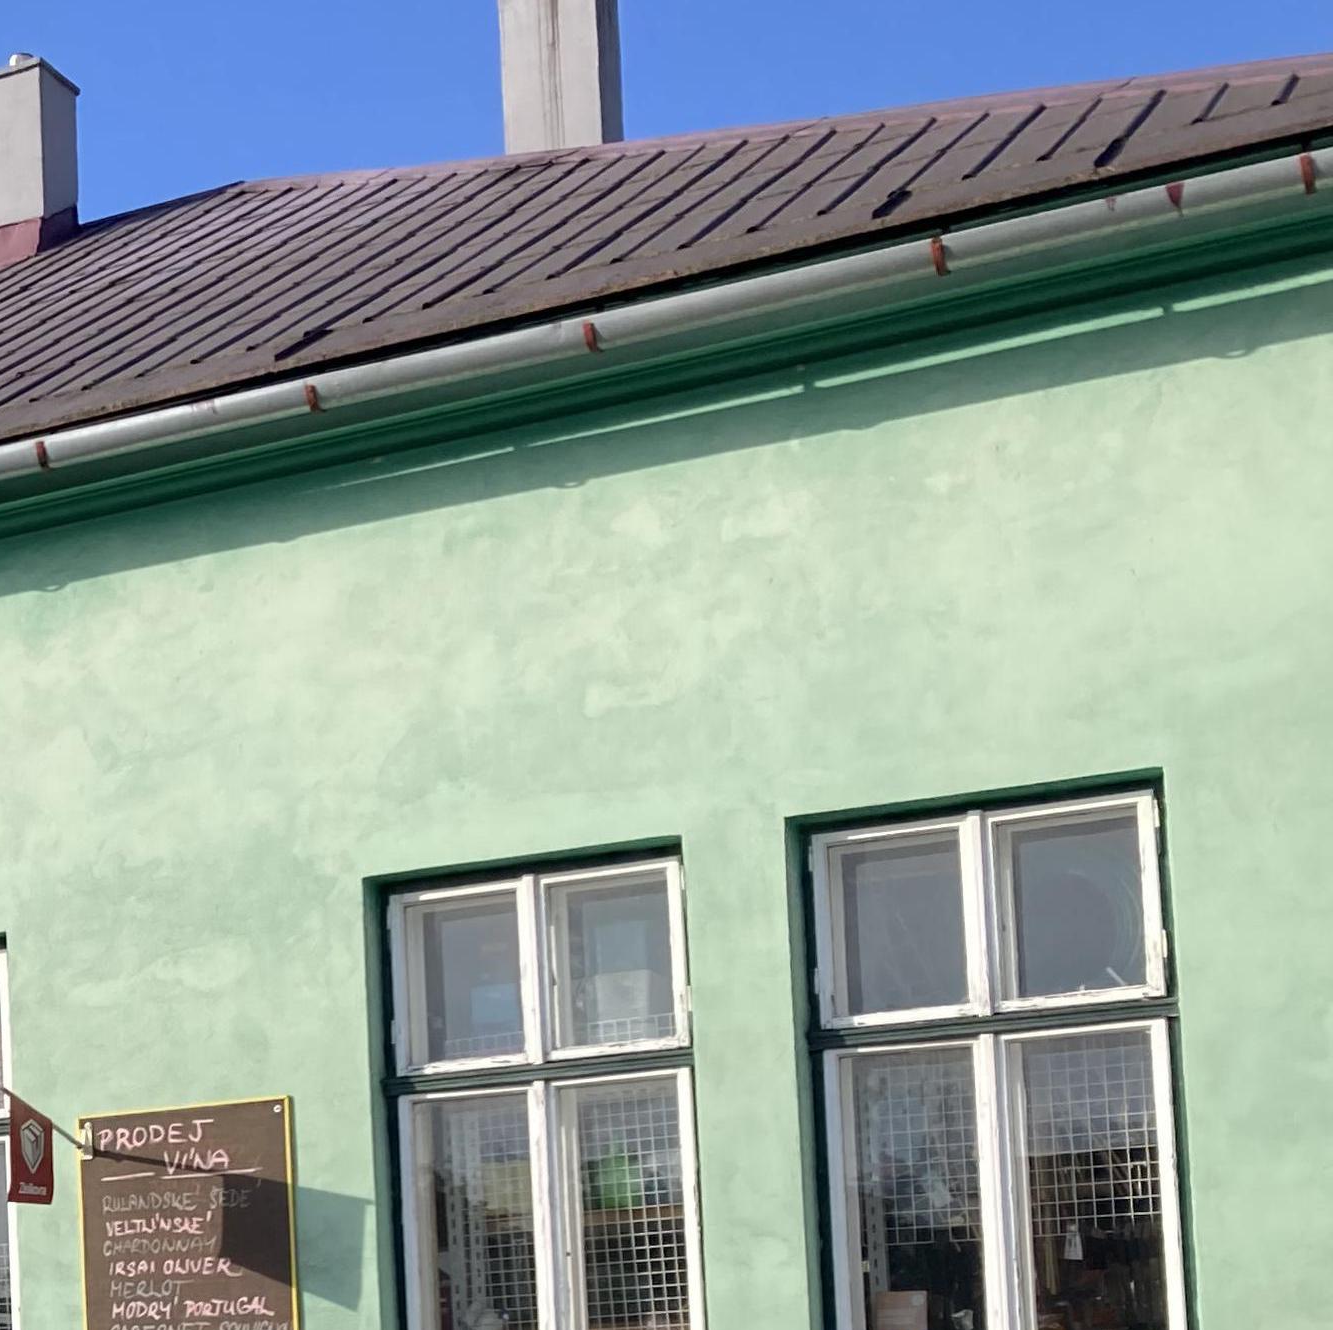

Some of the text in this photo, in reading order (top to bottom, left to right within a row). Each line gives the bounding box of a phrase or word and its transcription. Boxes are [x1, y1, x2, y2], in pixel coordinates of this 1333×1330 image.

[97, 1119, 215, 1151] PRODEJ
[163, 1147, 230, 1175] VÍNA
[102, 1235, 217, 1257] CHARDONNAY
[108, 1257, 243, 1278] IRSAI OLIVER
[109, 1279, 195, 1299] MERLOT
[111, 1295, 276, 1320] MODRÝ PORTUGAL
